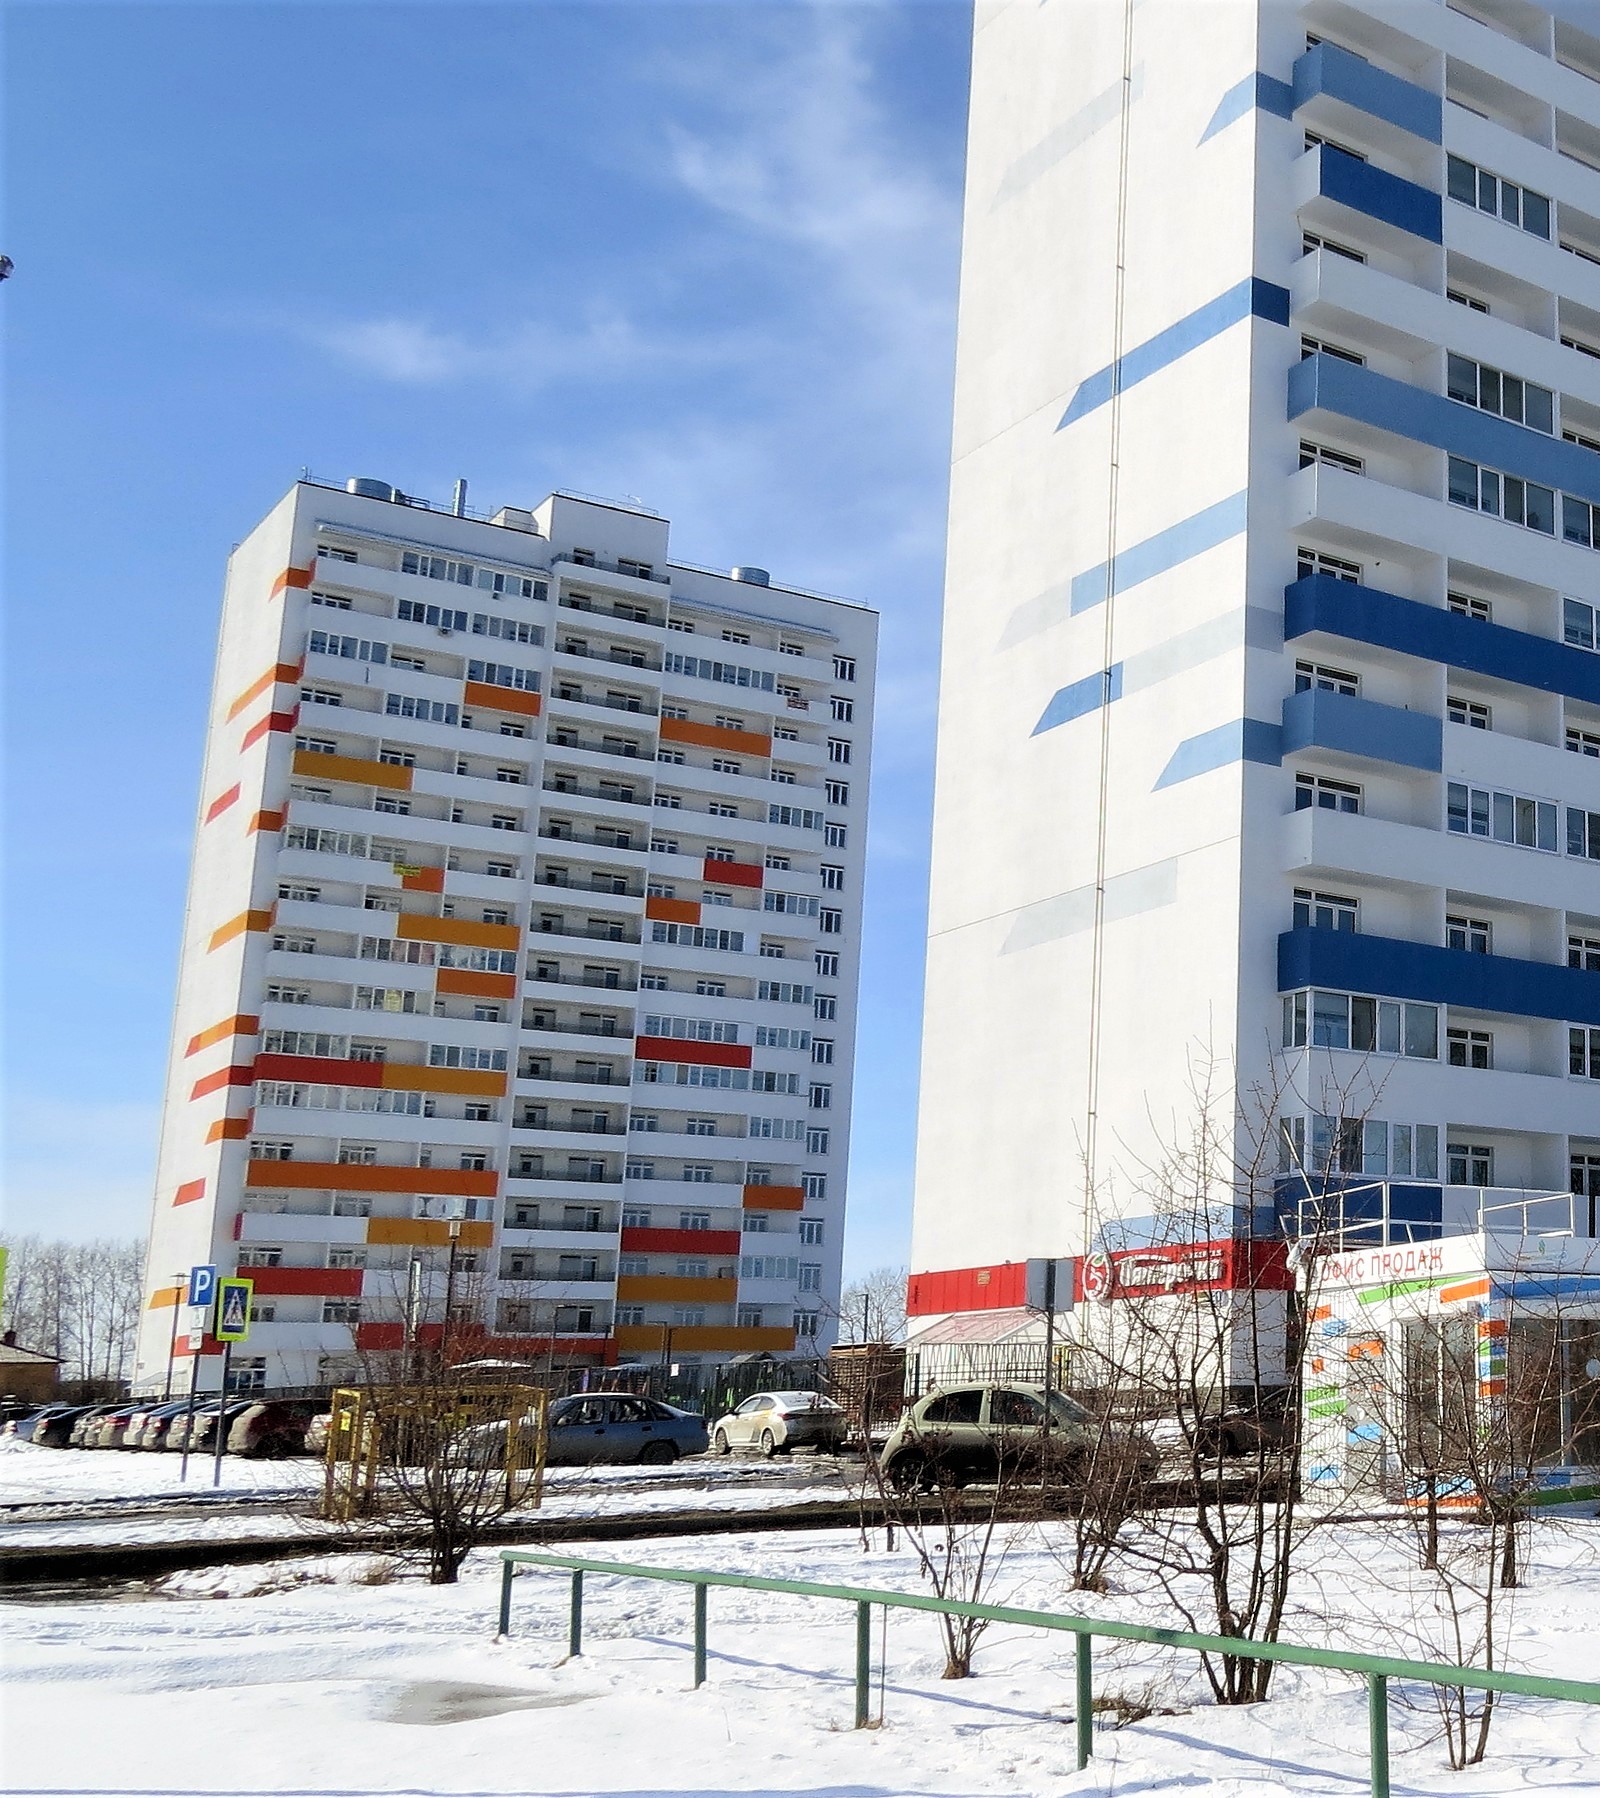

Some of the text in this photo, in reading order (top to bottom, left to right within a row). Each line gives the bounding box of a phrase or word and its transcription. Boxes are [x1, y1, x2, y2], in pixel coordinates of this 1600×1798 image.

[1321, 1247, 1443, 1281] ОФИС ПРОДАЖ
[193, 1269, 211, 1303] P
